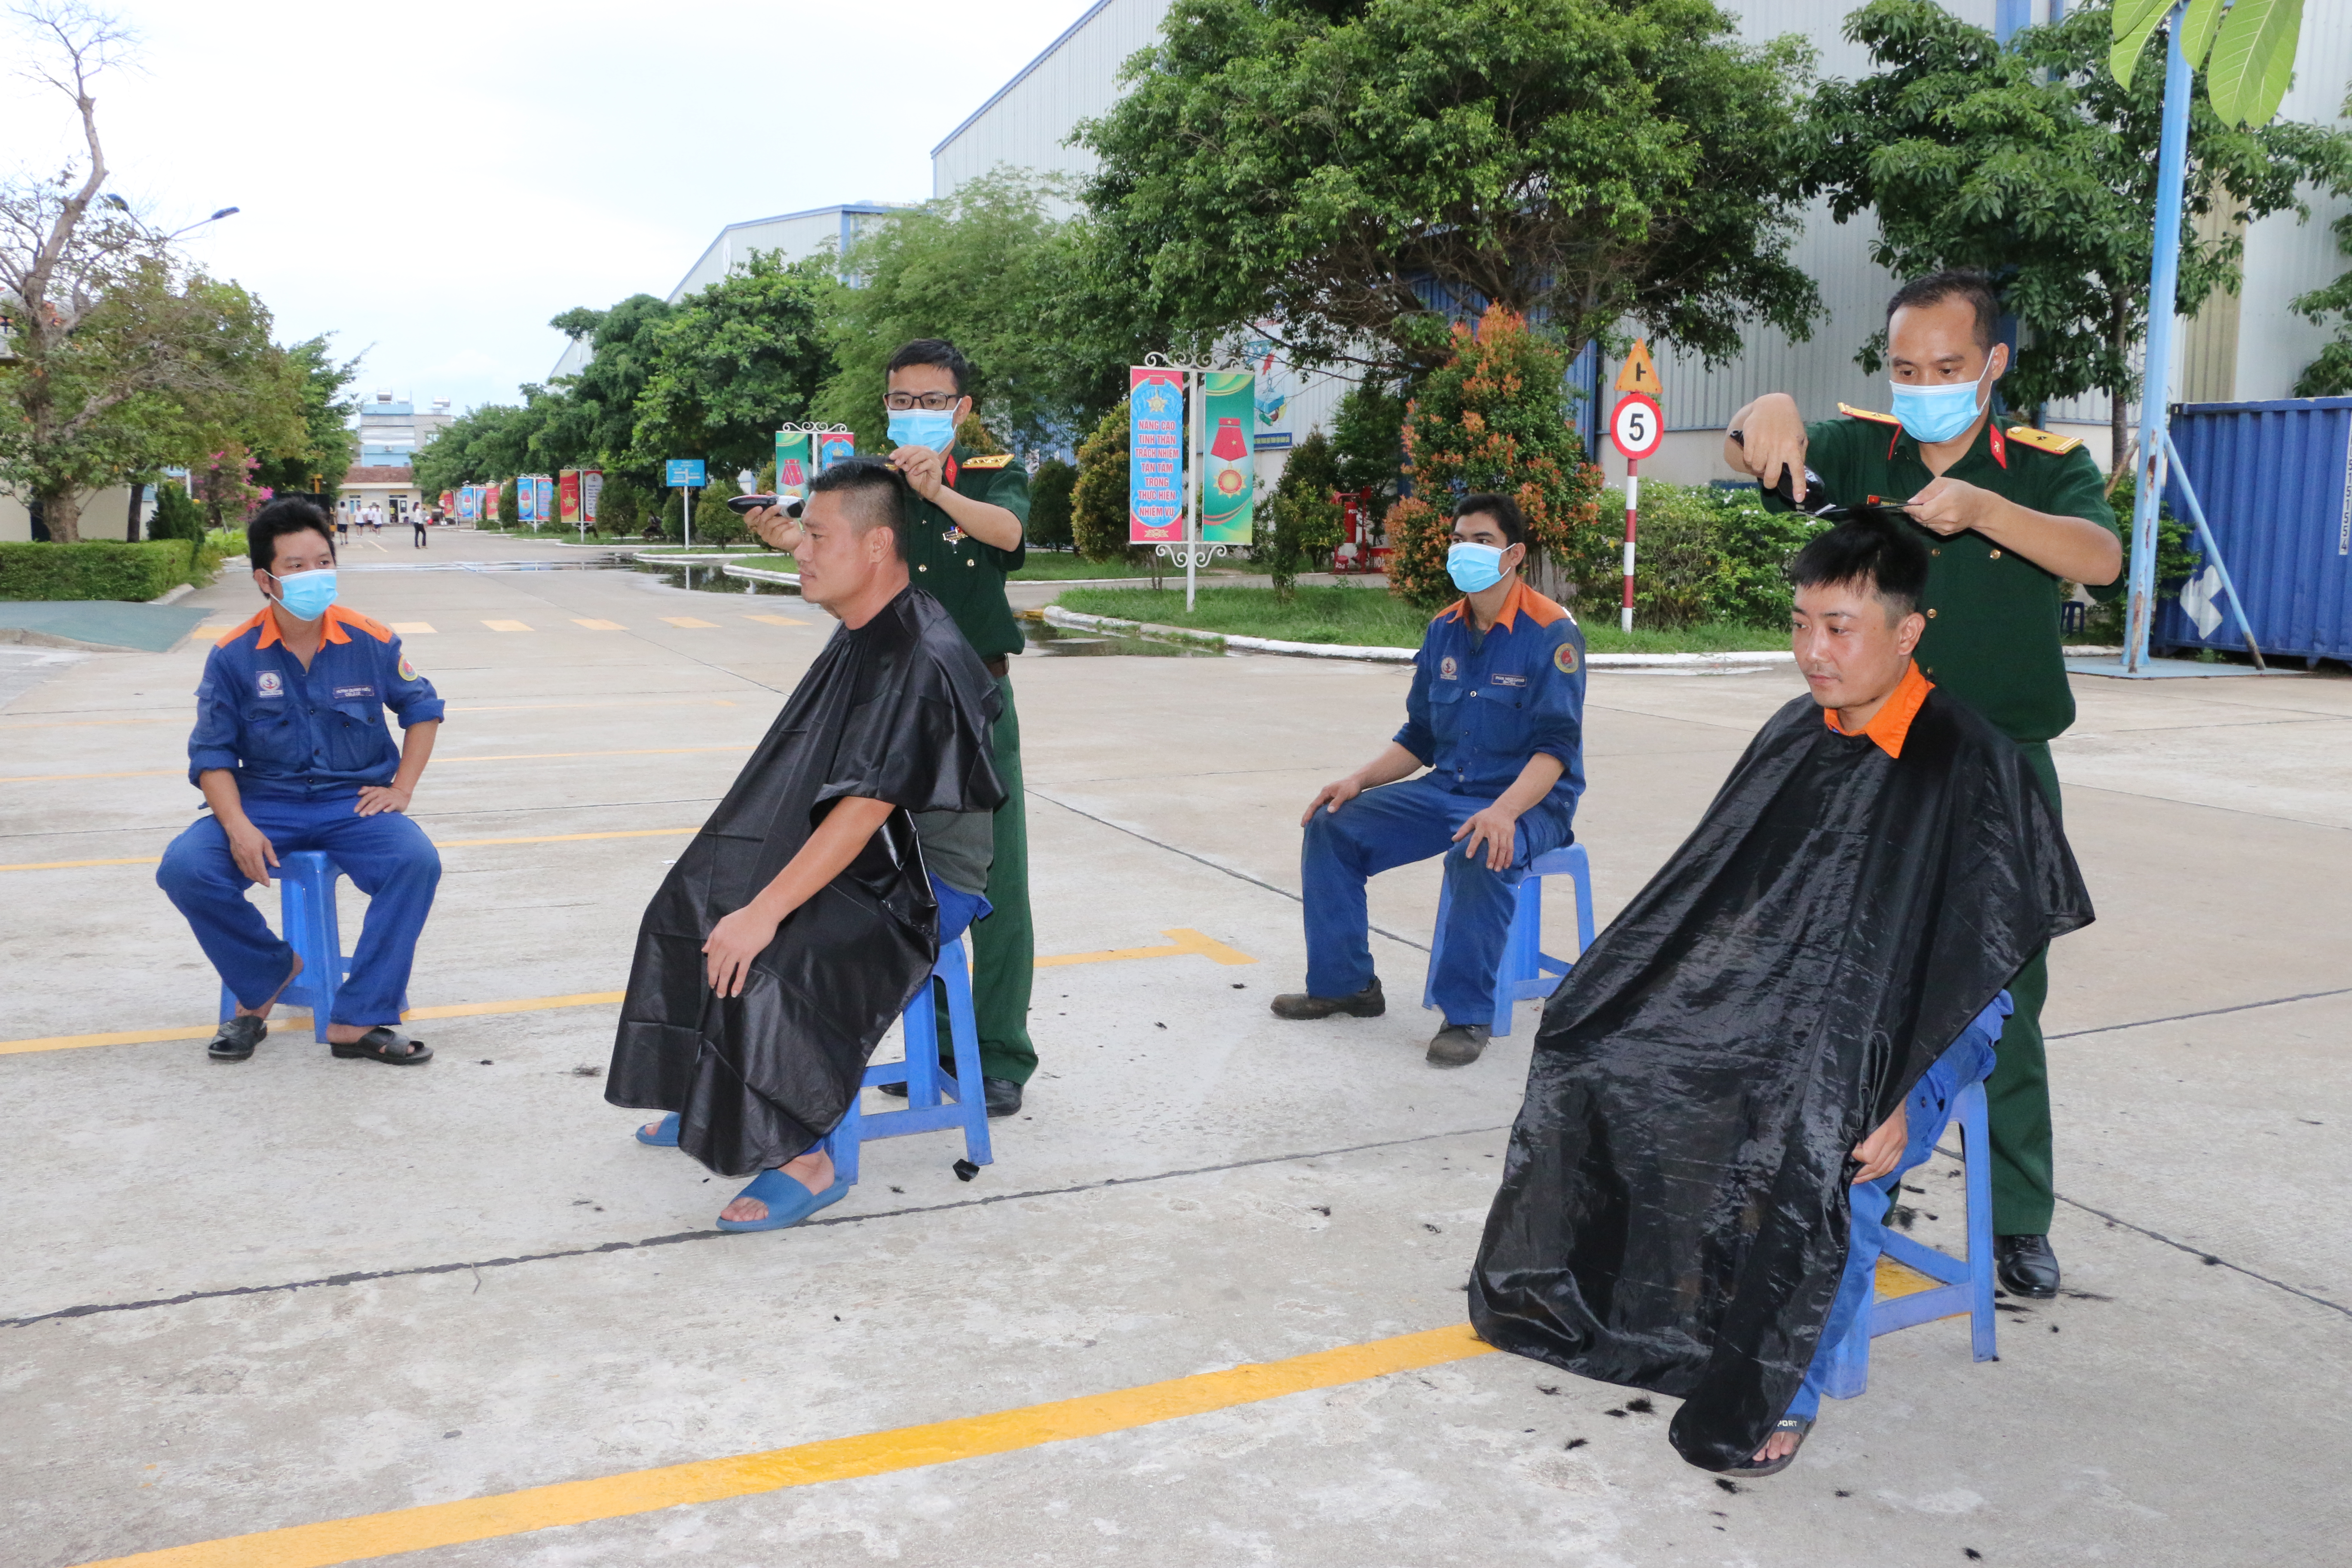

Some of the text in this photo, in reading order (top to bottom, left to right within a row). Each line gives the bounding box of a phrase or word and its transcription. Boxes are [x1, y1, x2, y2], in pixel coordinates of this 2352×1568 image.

[1139, 419, 1176, 430] NÂNG CAO
[1629, 413, 1644, 441] 5
[1138, 435, 1155, 444] TINH
[1135, 446, 1179, 460] TRÁCH NHIỆM
[1141, 461, 1173, 474] TẬN TÂM
[1145, 477, 1169, 487] TRONG
[1138, 489, 1176, 502] THỰC HIỆN
[1139, 505, 1174, 518] NHIỆM VỤ
